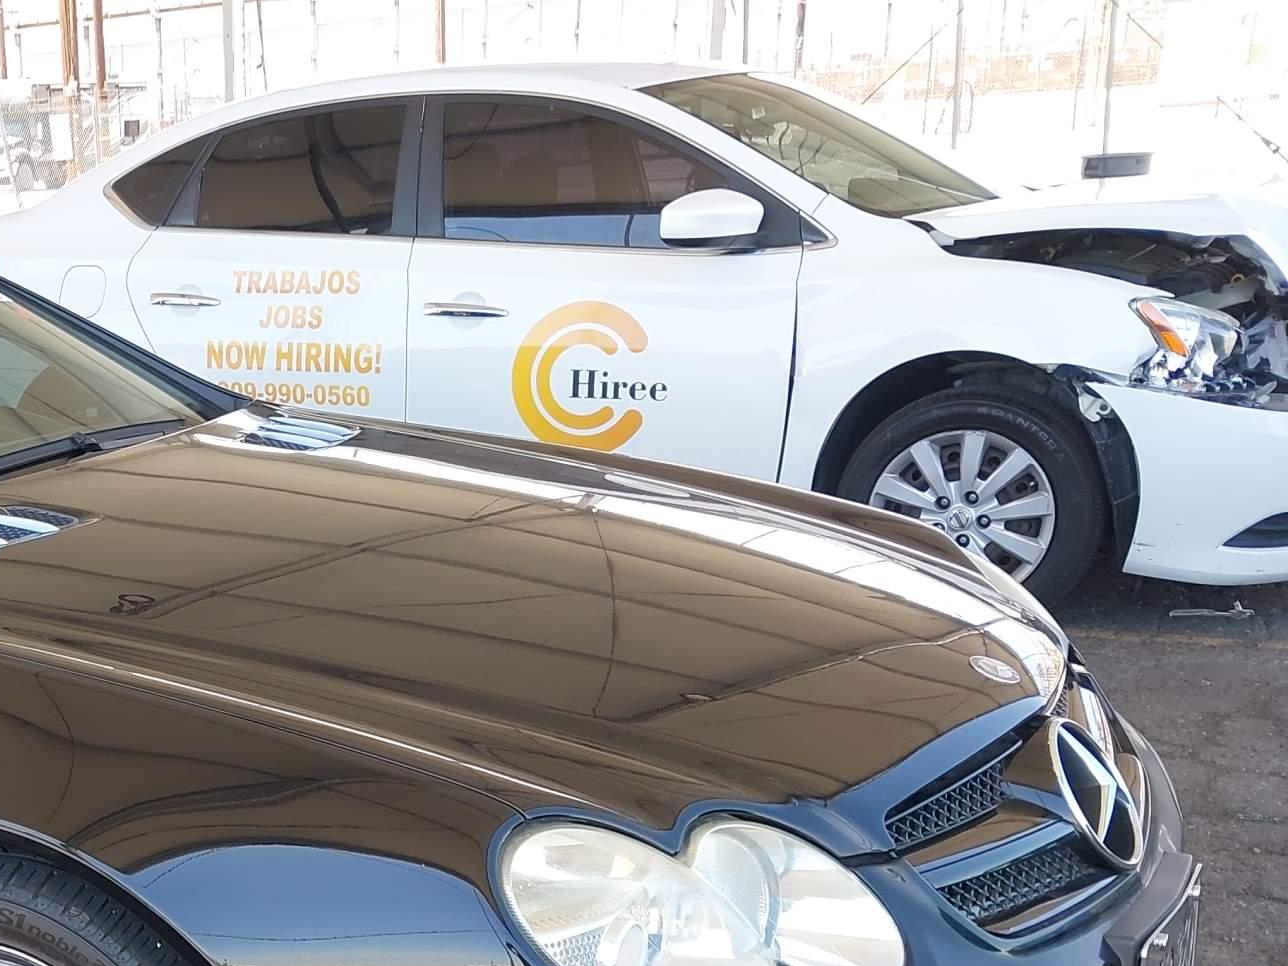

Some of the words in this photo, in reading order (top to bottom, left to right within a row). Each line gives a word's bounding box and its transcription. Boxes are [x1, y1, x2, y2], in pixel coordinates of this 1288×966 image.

[233, 270, 361, 295] TRABAJOS
[259, 304, 324, 330] JOBS
[206, 340, 268, 371] NOW
[275, 341, 383, 375] HIRING!
[569, 368, 668, 402] Hiree
[27, 925, 89, 964] noble
